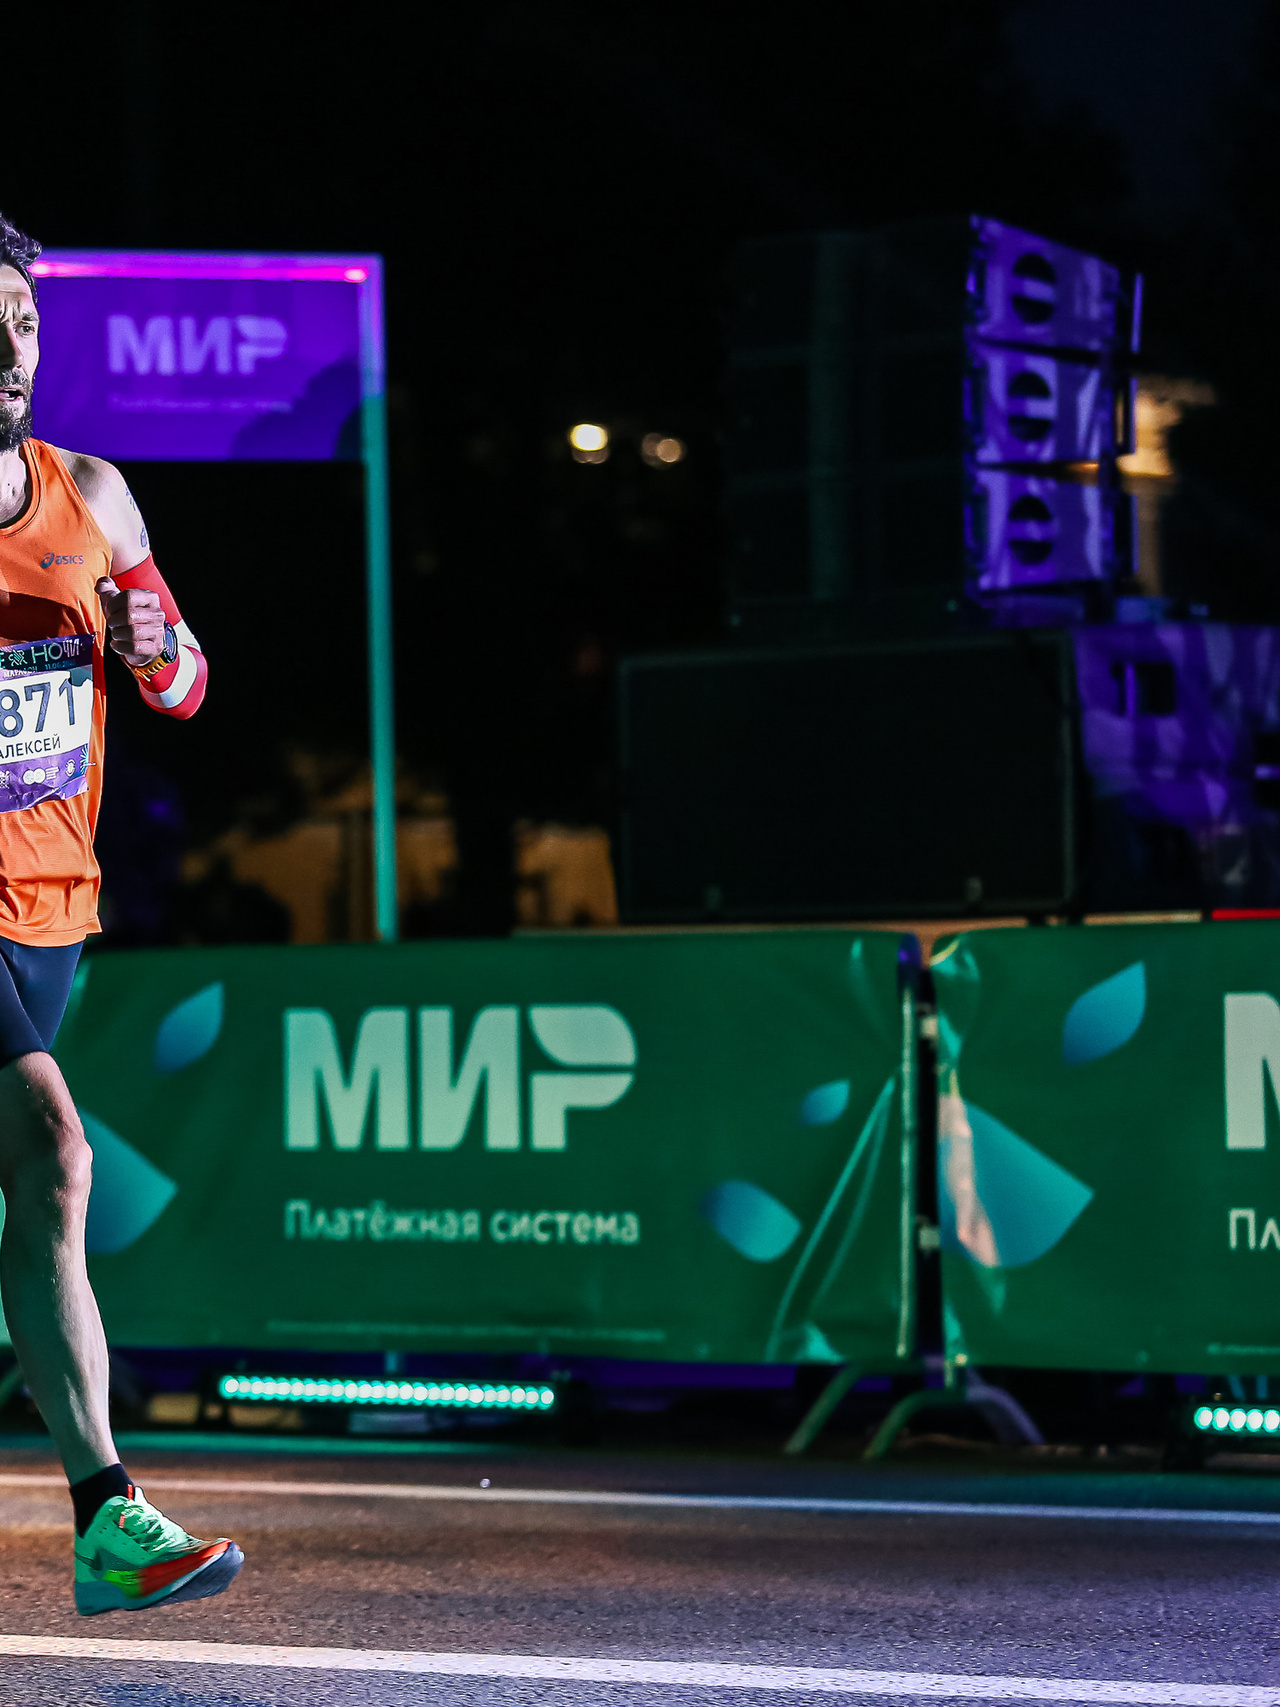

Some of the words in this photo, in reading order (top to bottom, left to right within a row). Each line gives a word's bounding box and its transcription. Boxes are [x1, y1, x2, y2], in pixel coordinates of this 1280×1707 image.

[107, 314, 289, 376] МИР
[30, 638, 80, 664] НОЧИ
[283, 1004, 638, 1151] МИР
[284, 1199, 480, 1241] Платёжная
[490, 1210, 641, 1244] система
